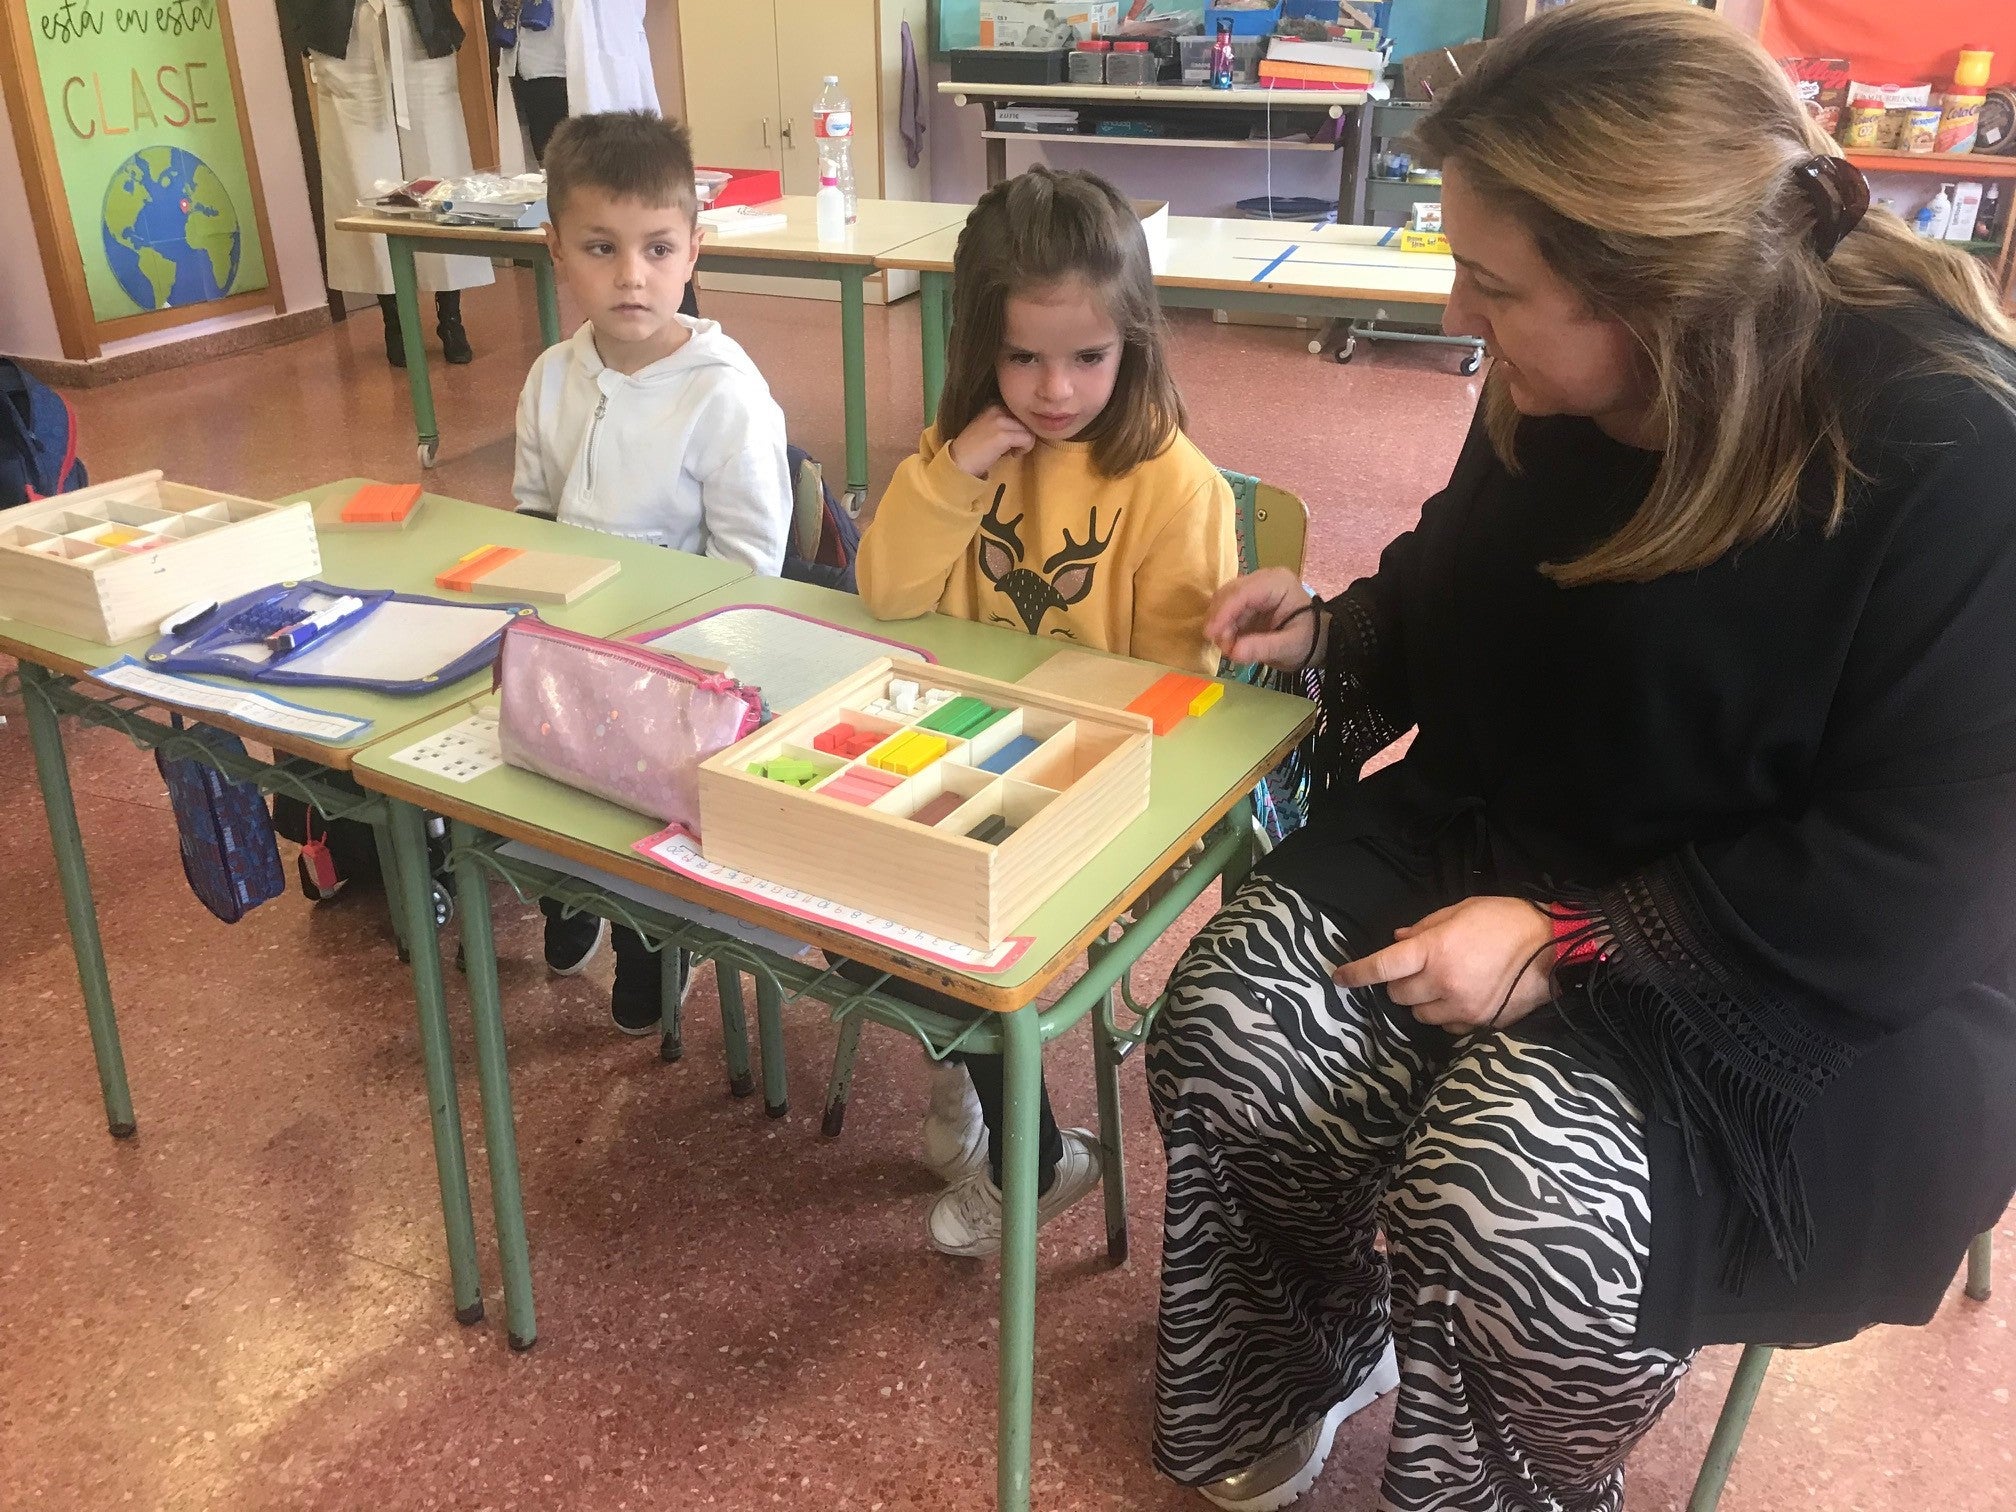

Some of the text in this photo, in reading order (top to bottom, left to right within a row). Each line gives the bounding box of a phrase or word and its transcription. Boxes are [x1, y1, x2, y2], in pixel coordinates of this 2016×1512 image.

[116, 8, 148, 33] en
[62, 62, 217, 140] CLASE
[666, 845, 684, 856] 20
[682, 853, 693, 863] 19
[696, 861, 708, 869] 18
[725, 871, 737, 880] 16
[740, 876, 752, 884] 15
[771, 886, 783, 894] 13
[785, 891, 799, 899] 12
[802, 895, 815, 903] 11
[817, 900, 831, 910] 10
[834, 906, 843, 914] 9
[850, 911, 862, 919] 8
[882, 921, 894, 929] 6
[899, 927, 911, 935] 5
[915, 931, 924, 940] 4
[932, 937, 944, 946] 3
[949, 942, 962, 951] 2
